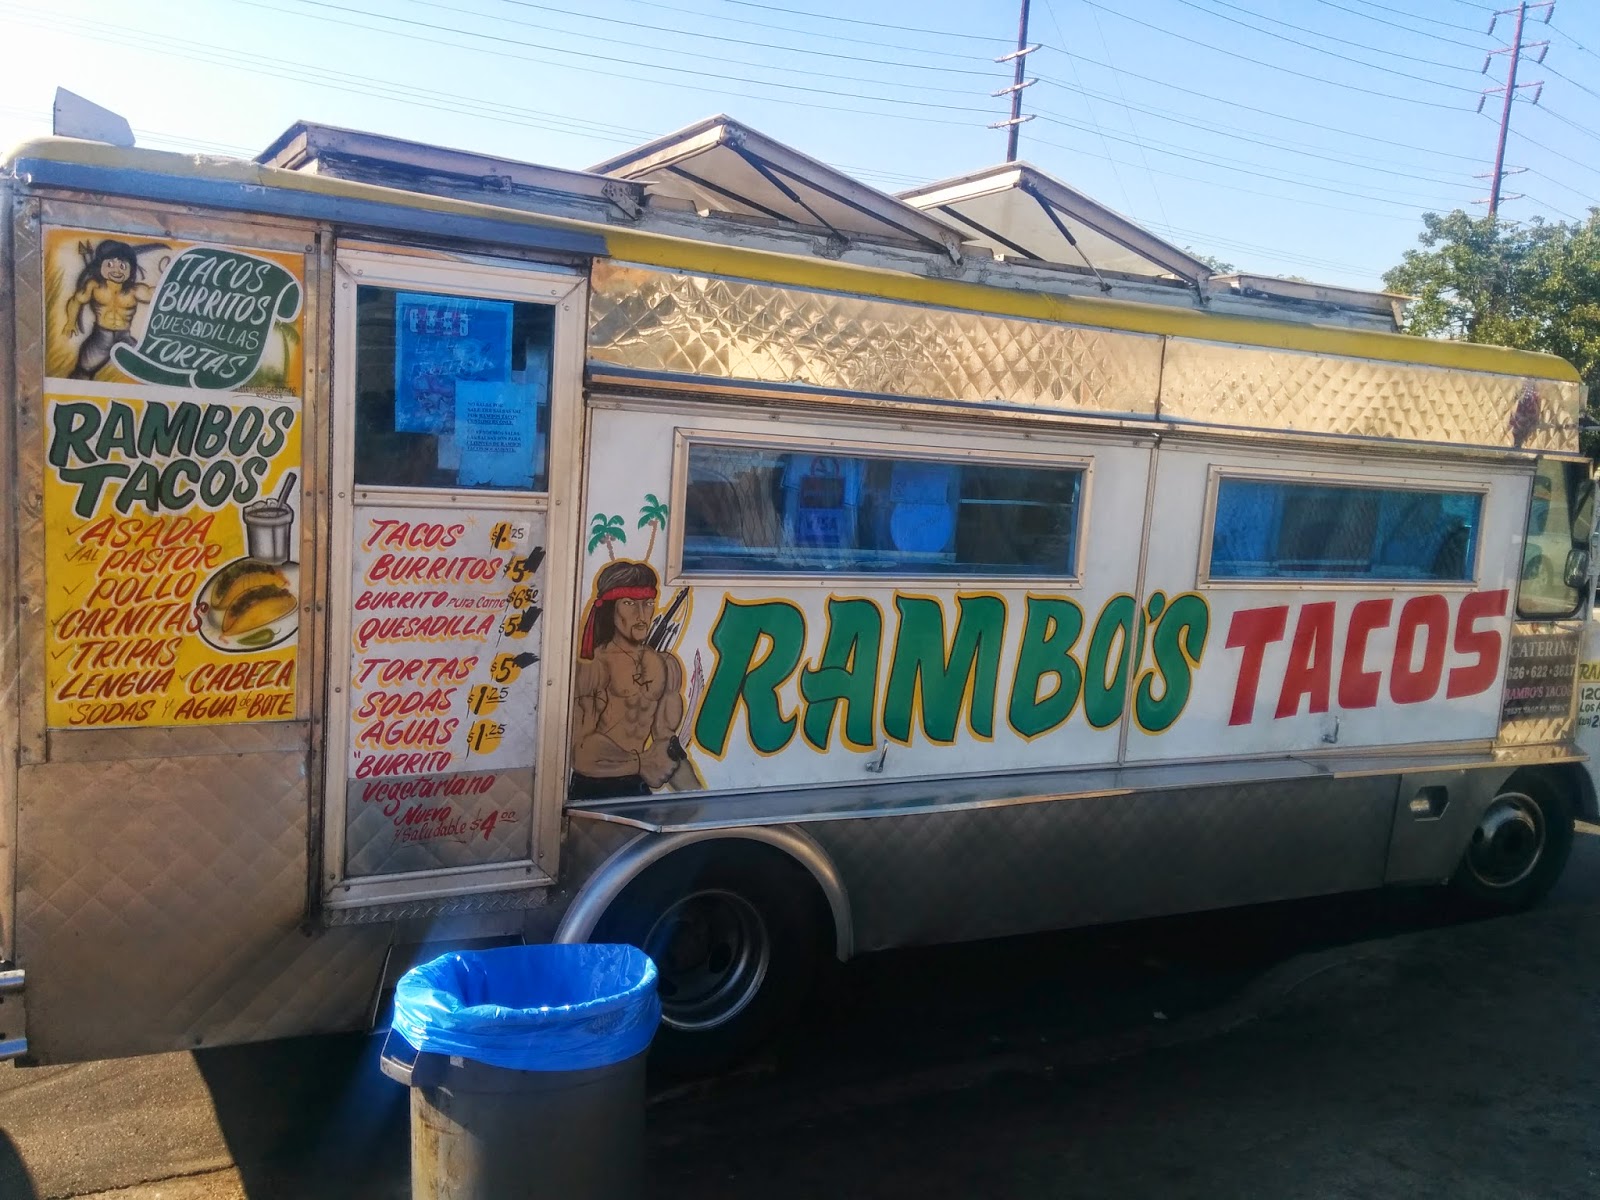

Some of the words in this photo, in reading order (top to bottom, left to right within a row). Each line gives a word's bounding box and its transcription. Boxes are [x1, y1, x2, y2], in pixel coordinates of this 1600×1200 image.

[179, 254, 271, 293] TACOS
[158, 282, 271, 325] BURRITOS
[150, 313, 260, 350] QUESADILLAS
[146, 334, 247, 378] TORTAS
[49, 400, 295, 467] RAMBOS
[59, 456, 268, 518] TACOS
[80, 514, 215, 548] ASADA
[366, 518, 465, 548] TACOS
[98, 544, 222, 577] PASTOR
[368, 554, 503, 581] BURRITOS
[86, 572, 196, 607] POLLO
[355, 591, 449, 610] BURRITO
[475, 596, 506, 609] Carne
[58, 602, 209, 639] CARNITAS
[358, 614, 496, 648] QUESADILLA
[72, 637, 183, 670] TRIPAS
[1510, 640, 1578, 658] CATERING
[57, 668, 175, 700] LENGUA
[189, 659, 294, 694] CABEZA
[359, 655, 479, 684] TORTAS
[691, 590, 1209, 760] RAMBO'S
[1225, 589, 1510, 726] TACOS
[174, 695, 237, 720] AGUA
[247, 693, 293, 718] BOTE
[358, 687, 458, 718] SODAS
[466, 684, 509, 719] $1.25
[1505, 685, 1544, 700] RAMBO'S
[360, 717, 460, 746] AGUAS
[465, 721, 507, 761] $1.25
[402, 815, 467, 843] Saludable
